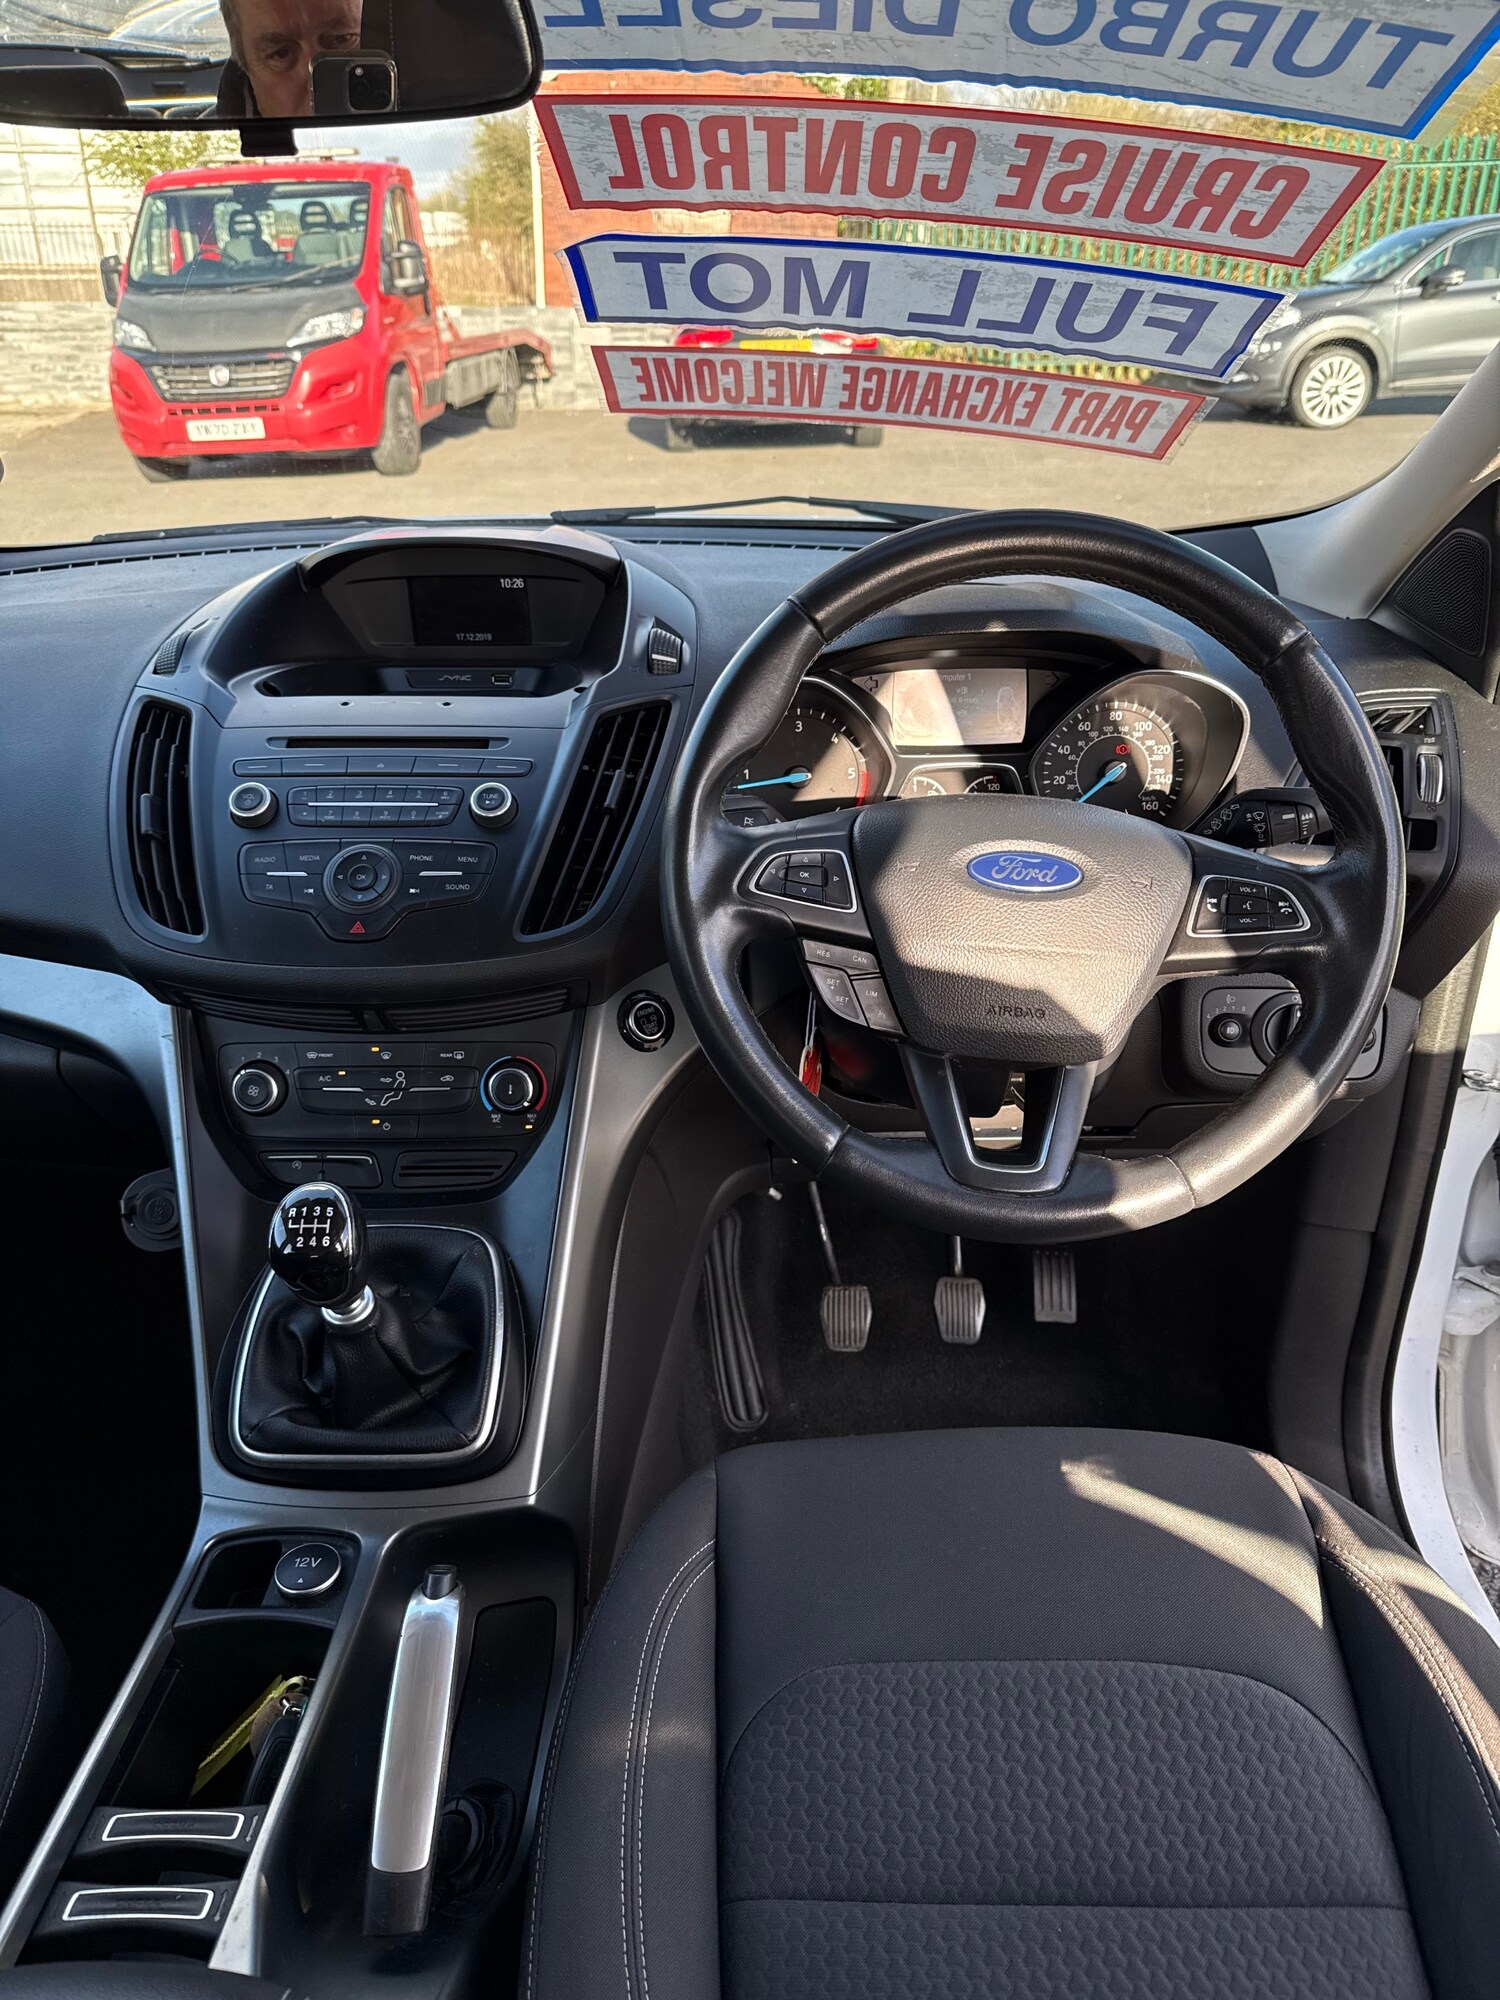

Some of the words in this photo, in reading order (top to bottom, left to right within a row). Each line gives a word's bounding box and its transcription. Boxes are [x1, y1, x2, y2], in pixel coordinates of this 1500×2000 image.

[500, 578, 524, 588] 10:26
[456, 633, 492, 641] 17.12.2019
[1109, 711, 1122, 721] 80
[795, 721, 802, 732] 3
[1077, 721, 1091, 731] 60
[1134, 721, 1152, 731] 100
[831, 732, 838, 744] 4
[1058, 745, 1070, 754] 40
[1153, 745, 1171, 754] 120
[743, 769, 749, 780] 1
[847, 768, 856, 779] 5
[1053, 775, 1066, 785] 20
[1155, 774, 1172, 784] 140
[1141, 801, 1159, 811] 160
[991, 855, 1059, 883] Ford
[817, 949, 830, 957] RES
[852, 955, 867, 964] CAN
[986, 1005, 1045, 1019] AIRBAG
[288, 1207, 297, 1217] R
[301, 1206, 307, 1216] 1
[313, 1206, 321, 1216] 3
[326, 1207, 334, 1217] 5
[296, 1236, 304, 1247] 2
[309, 1236, 317, 1247] 4
[322, 1236, 330, 1247] 6
[294, 1557, 322, 1568] 12V
